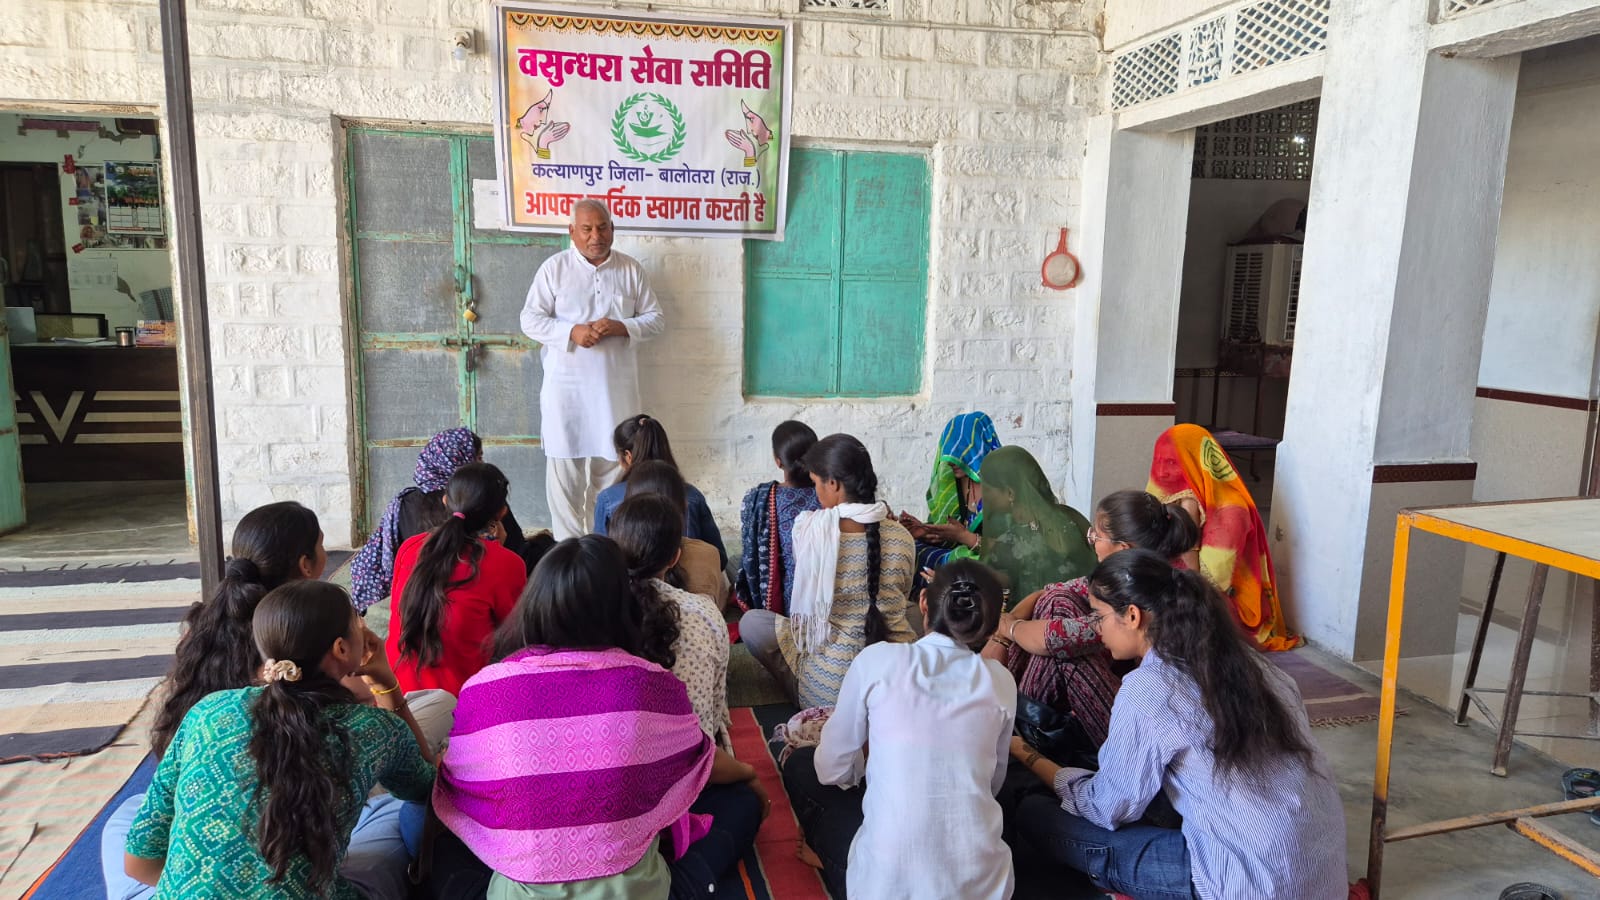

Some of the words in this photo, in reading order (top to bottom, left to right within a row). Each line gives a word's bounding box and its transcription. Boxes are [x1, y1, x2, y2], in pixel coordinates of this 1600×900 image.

[518, 49, 623, 87] वसुन्धरा
[630, 44, 683, 85] सेवा
[689, 49, 771, 89] समिति
[532, 163, 604, 187] कल्याणपुर
[658, 163, 715, 184] बालोतरा
[721, 167, 761, 188] (राज.)
[525, 191, 584, 217] आपक
[645, 196, 702, 221] स्वागत
[704, 191, 751, 222] करती
[753, 191, 767, 223] है
